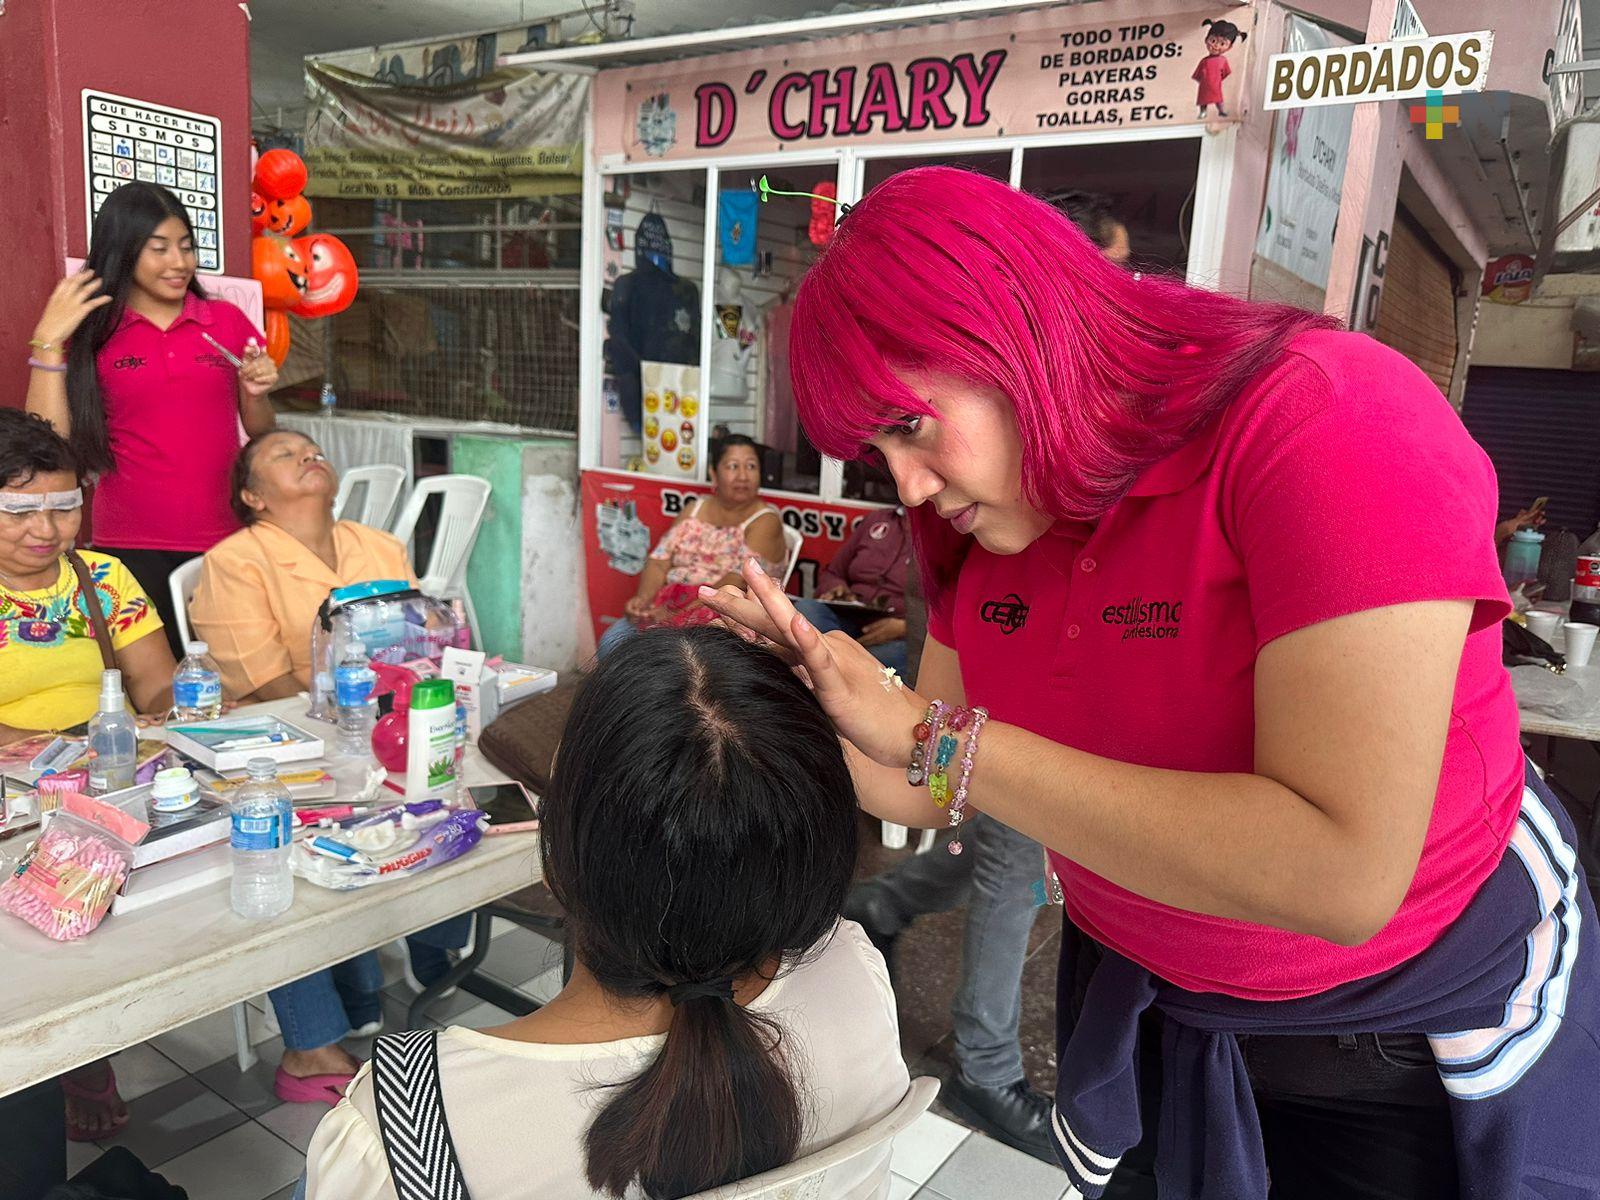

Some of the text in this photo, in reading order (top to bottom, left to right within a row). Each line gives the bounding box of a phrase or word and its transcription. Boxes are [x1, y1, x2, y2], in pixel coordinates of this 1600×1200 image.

[1060, 23, 1165, 48] TODO TIPO
[1040, 42, 1183, 69] DE BORDADOS:
[1058, 65, 1157, 87] PLAYERAS
[1271, 38, 1481, 102] BORDADOS
[1066, 87, 1145, 106] GORRAS
[99, 102, 127, 116] QUE
[135, 110, 179, 127] HACER
[1036, 105, 1174, 127] TOALLAS, ETC.
[108, 119, 200, 148] SISMOS
[102, 179, 209, 206] INIOS
